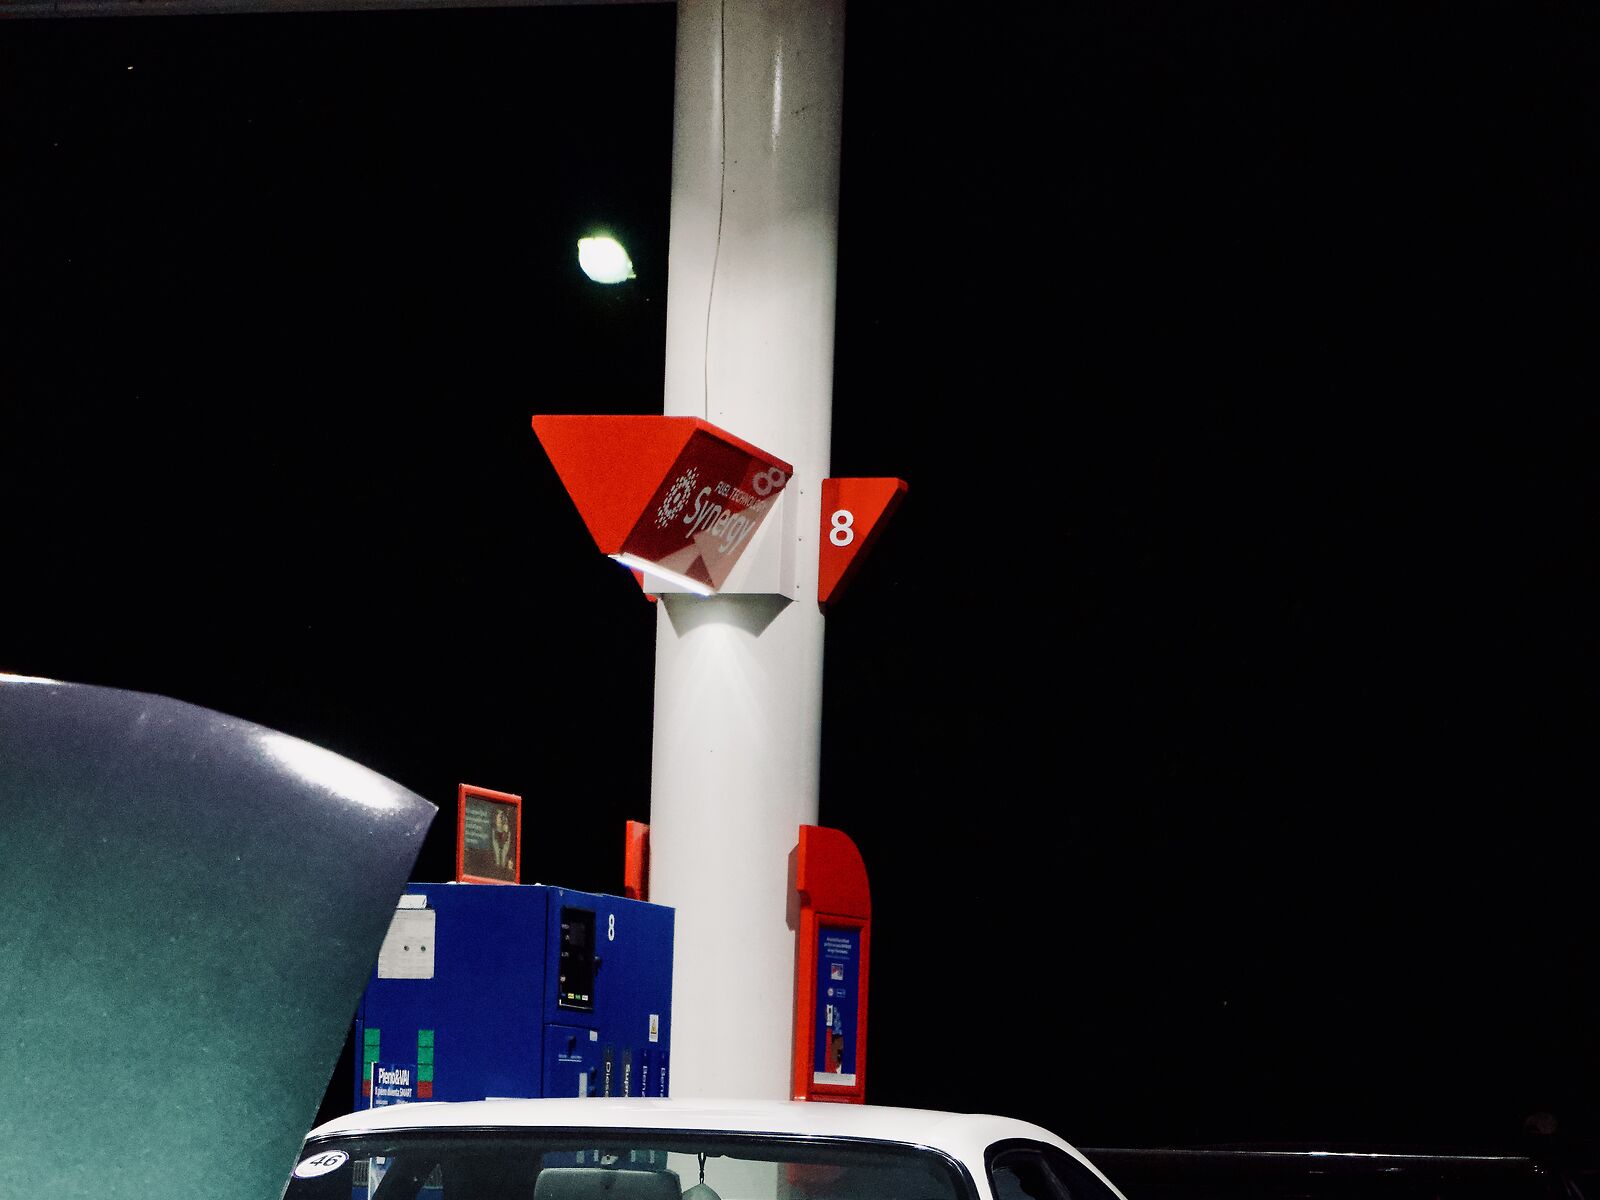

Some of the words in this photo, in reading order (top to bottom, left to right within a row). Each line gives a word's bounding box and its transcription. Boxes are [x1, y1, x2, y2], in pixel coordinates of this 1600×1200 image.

[715, 480, 731, 497] FUEL
[752, 466, 786, 496] 8
[683, 486, 756, 555] Synergy
[829, 509, 854, 546] 8
[608, 913, 615, 942] 8
[310, 1155, 342, 1166] 46
